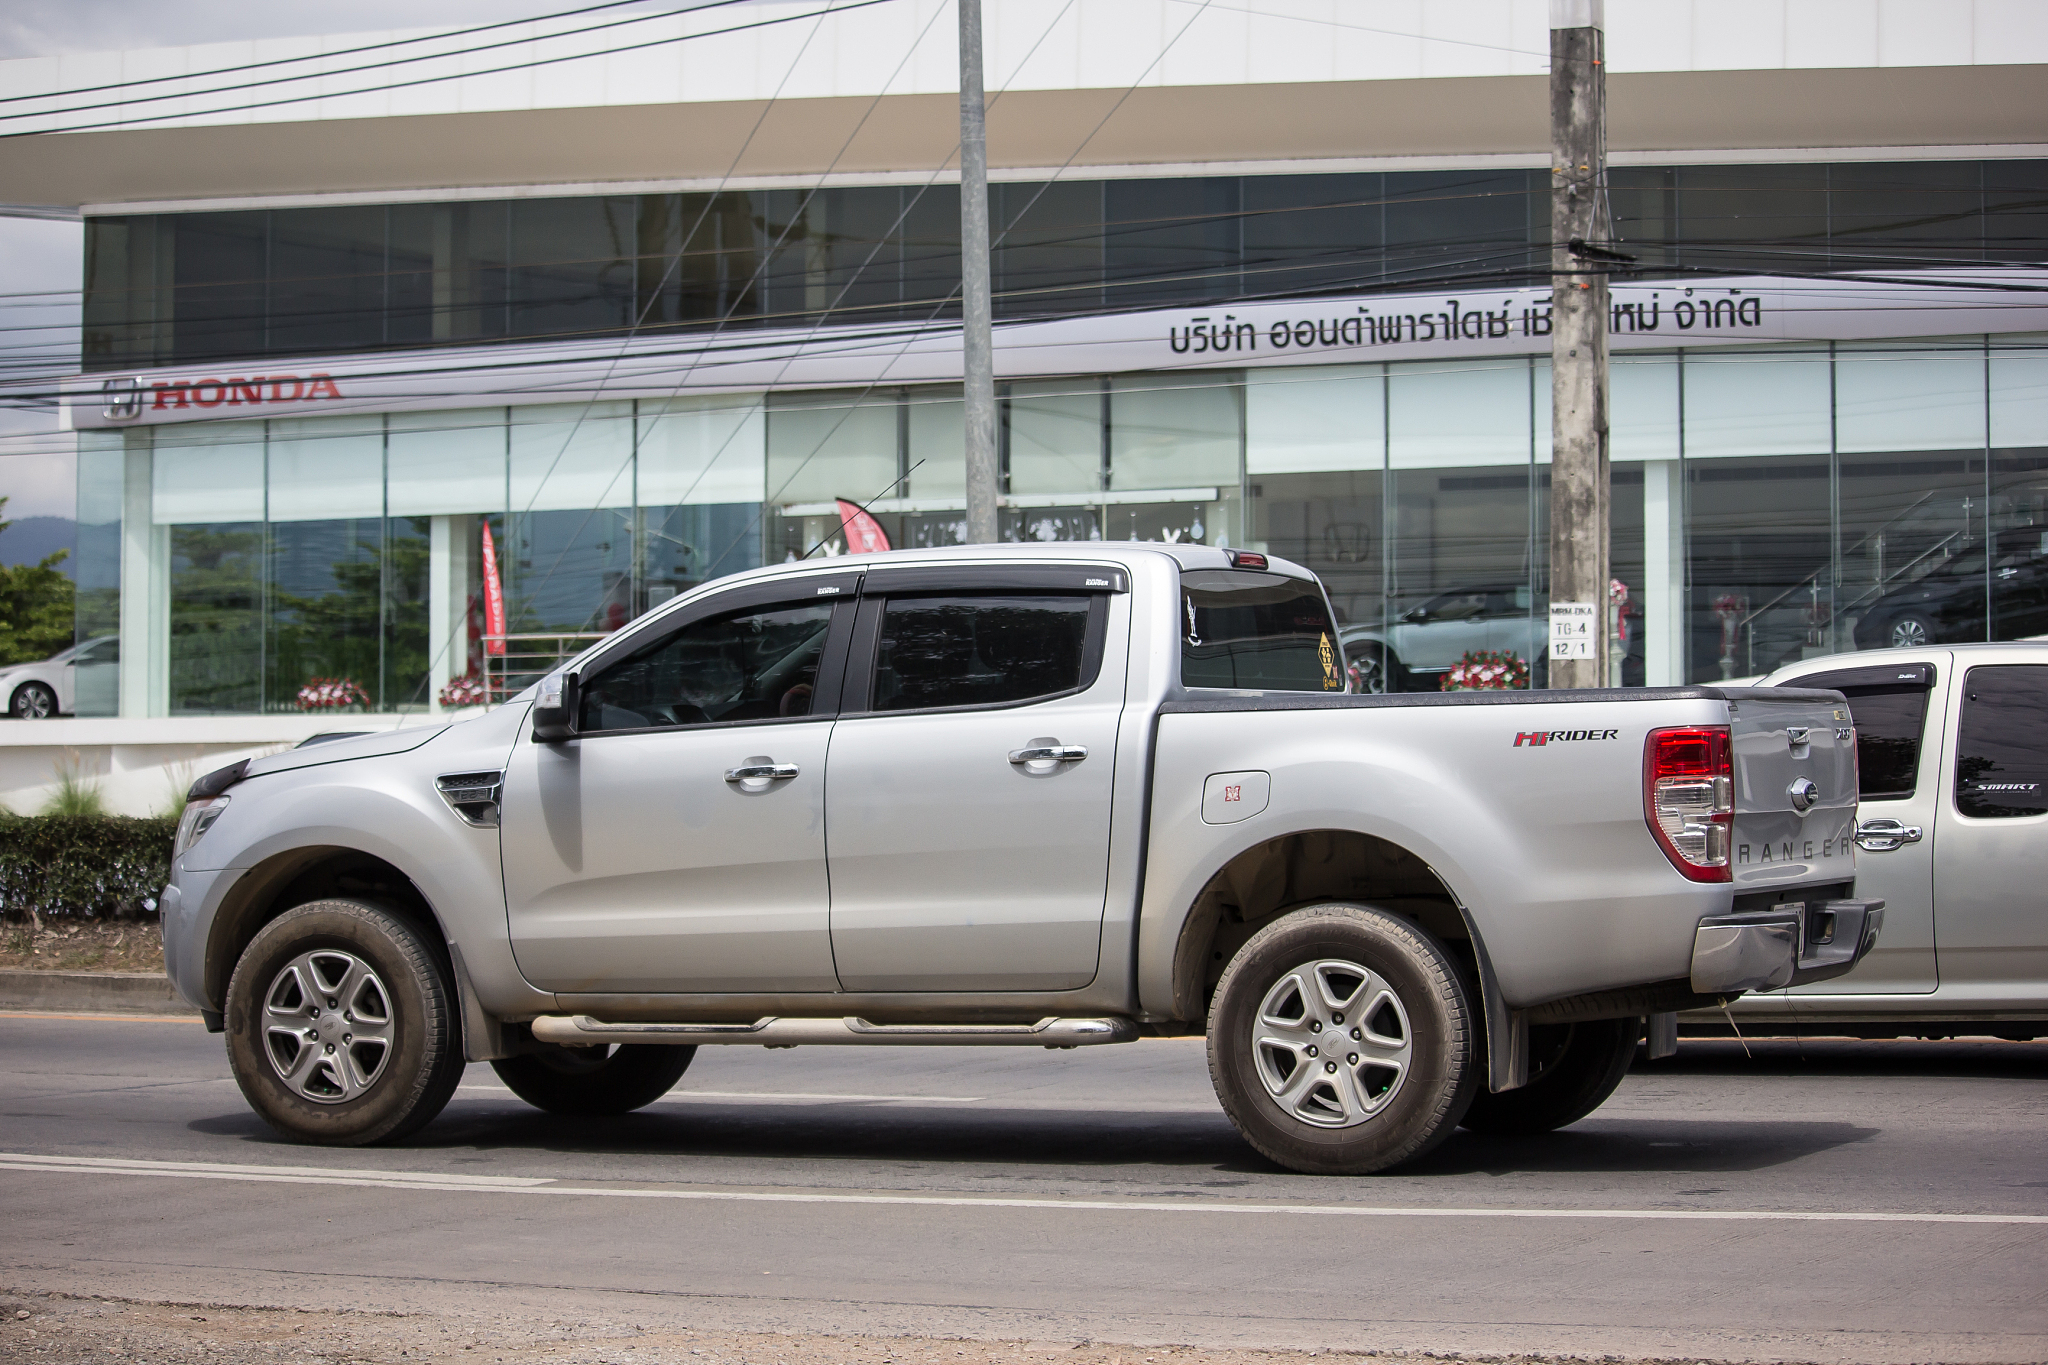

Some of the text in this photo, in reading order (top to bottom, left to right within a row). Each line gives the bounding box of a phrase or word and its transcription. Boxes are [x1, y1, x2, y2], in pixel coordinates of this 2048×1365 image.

[1170, 314, 1256, 354] บริษัท
[1674, 287, 1761, 330] จำกัด
[151, 373, 345, 411] HONDA
[1555, 622, 1587, 636] TG-4
[1974, 783, 2040, 791] SMART
[1738, 837, 1851, 864] RANGER
